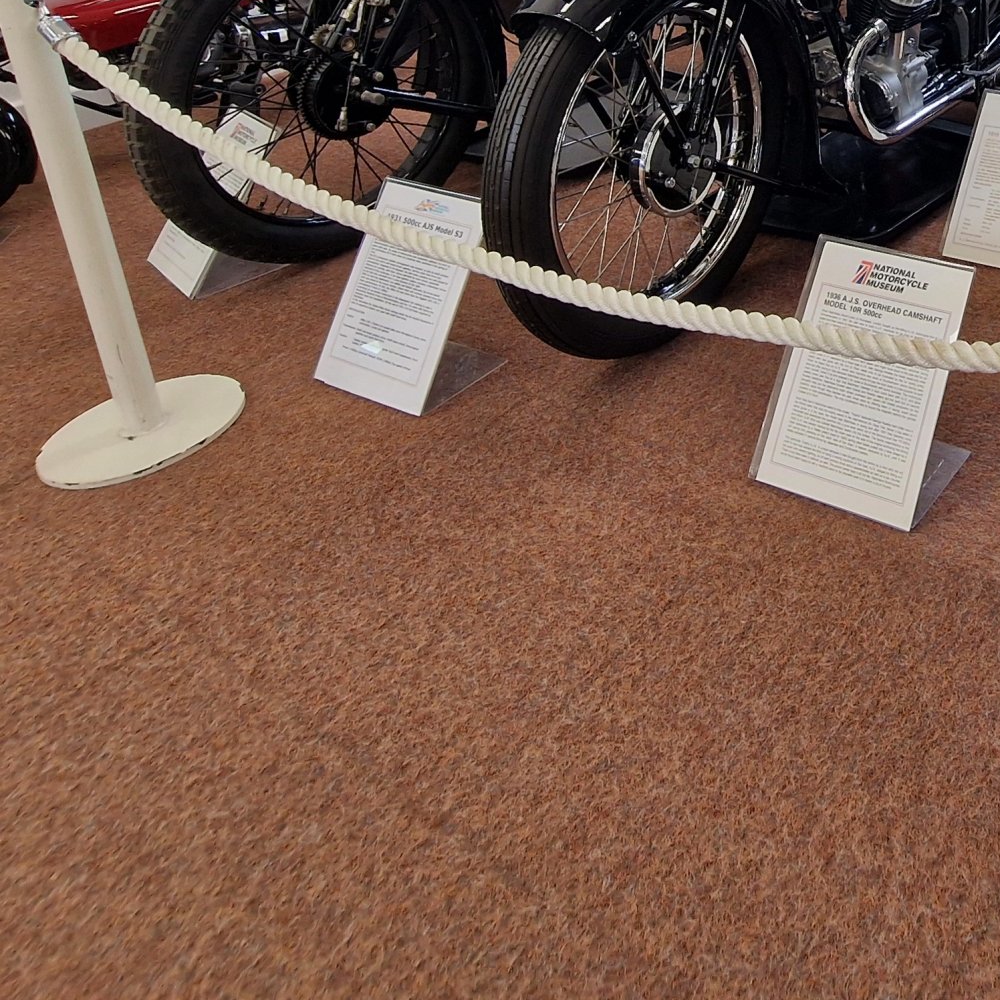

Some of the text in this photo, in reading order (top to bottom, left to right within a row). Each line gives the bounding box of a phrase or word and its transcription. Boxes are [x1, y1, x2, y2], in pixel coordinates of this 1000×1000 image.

[402, 216, 422, 228] 500cc
[422, 222, 435, 230] AJS
[435, 225, 454, 236] Model
[869, 271, 929, 291] MOTORCYCLE
[873, 263, 916, 279] NATIONAL
[866, 279, 905, 294] MUSEUM
[824, 299, 848, 312] MODEL
[862, 308, 883, 320] 500cc
[842, 294, 860, 306] A.J.S.
[862, 299, 901, 315] OVERHEAD
[902, 308, 943, 325] CAMSHAFT
